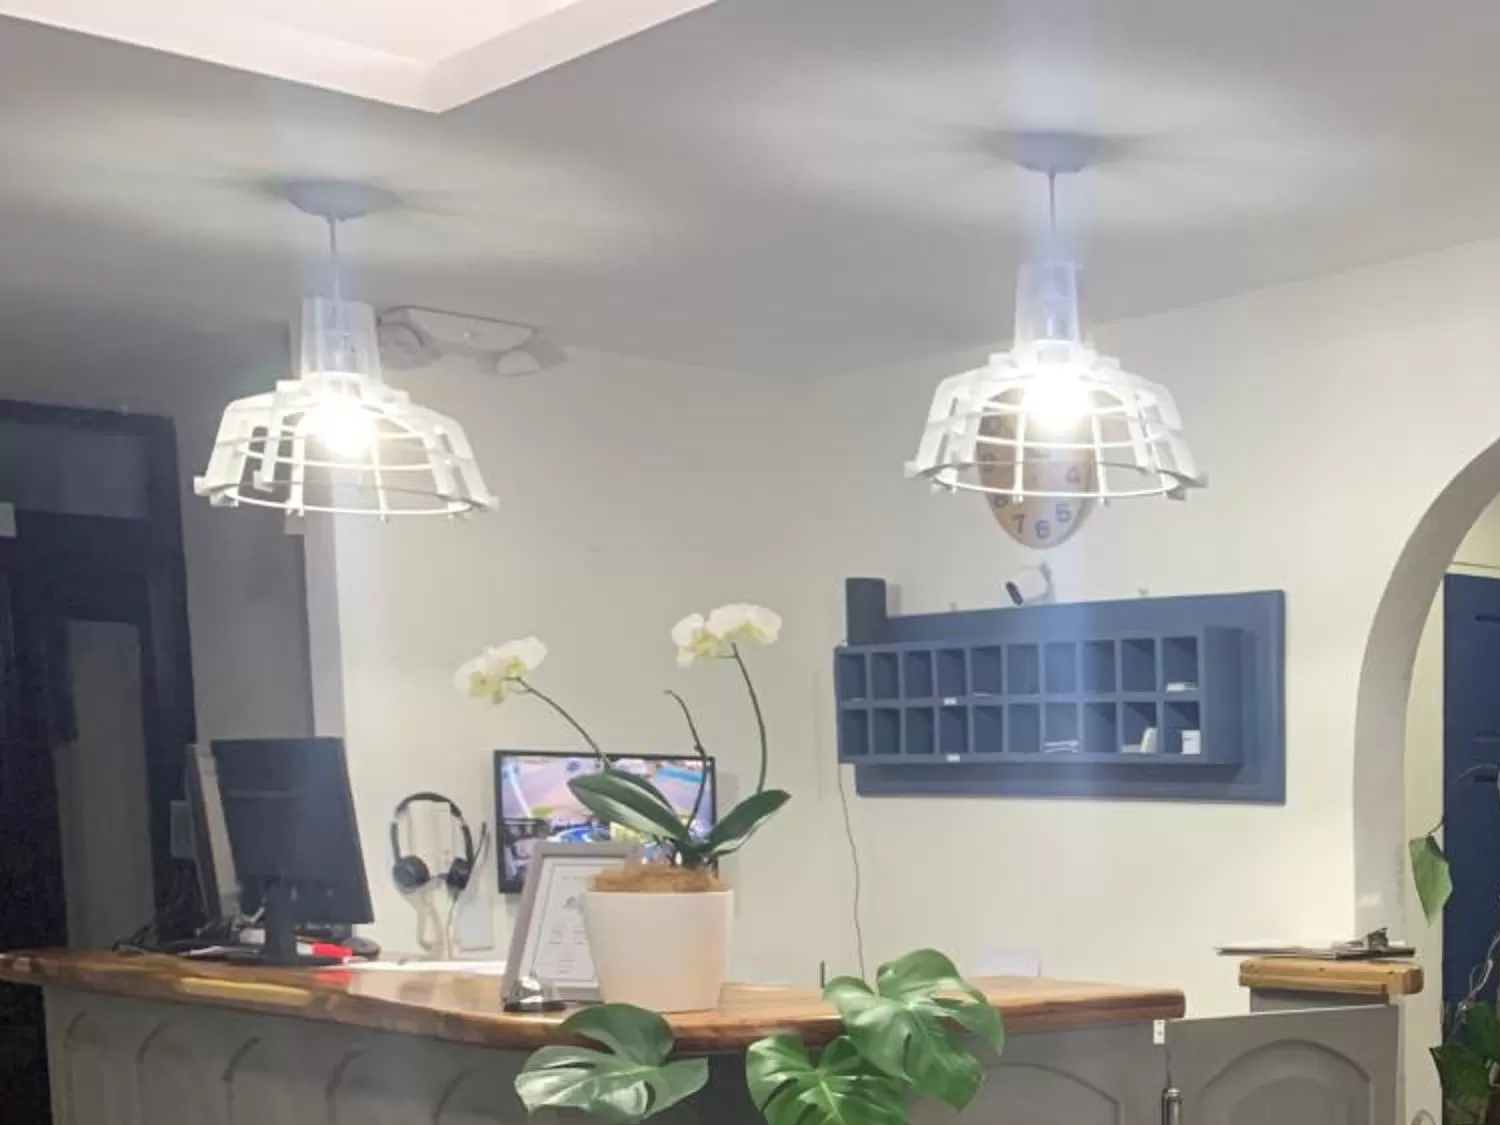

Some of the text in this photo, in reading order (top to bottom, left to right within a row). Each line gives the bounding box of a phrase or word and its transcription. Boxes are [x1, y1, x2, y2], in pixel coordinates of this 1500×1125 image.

[1056, 504, 1071, 523] 5
[1011, 514, 1025, 534] 7
[1035, 519, 1050, 539] 6
